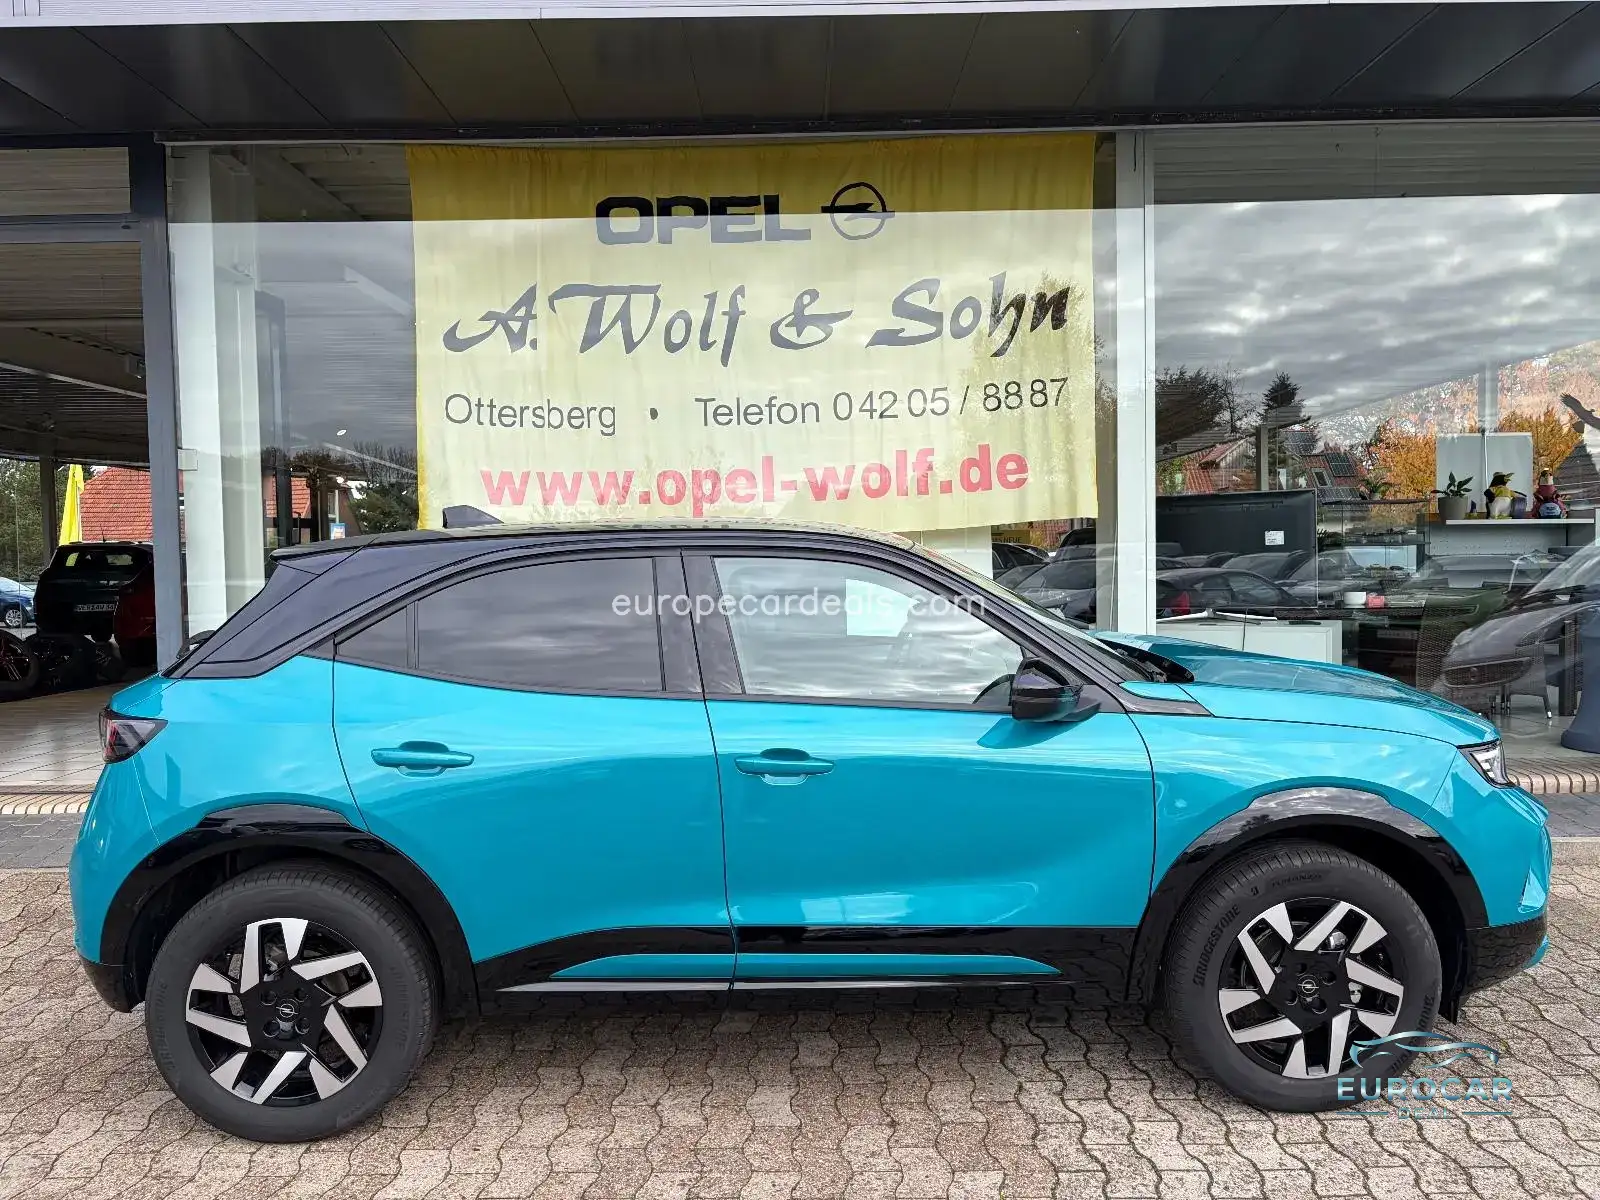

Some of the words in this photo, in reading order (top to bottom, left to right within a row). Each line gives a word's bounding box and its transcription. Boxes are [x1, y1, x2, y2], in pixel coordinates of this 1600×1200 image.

[595, 194, 811, 245] OPEL
[442, 282, 537, 352] A.
[547, 283, 745, 367] Wolf
[770, 288, 853, 350] &
[865, 271, 1070, 358] Sohn
[445, 393, 616, 436] Ottersberg
[695, 396, 820, 427] Telefon
[480, 444, 1030, 518] www.opel-wolf.de
[1193, 903, 1241, 987] BRIDGESTONE
